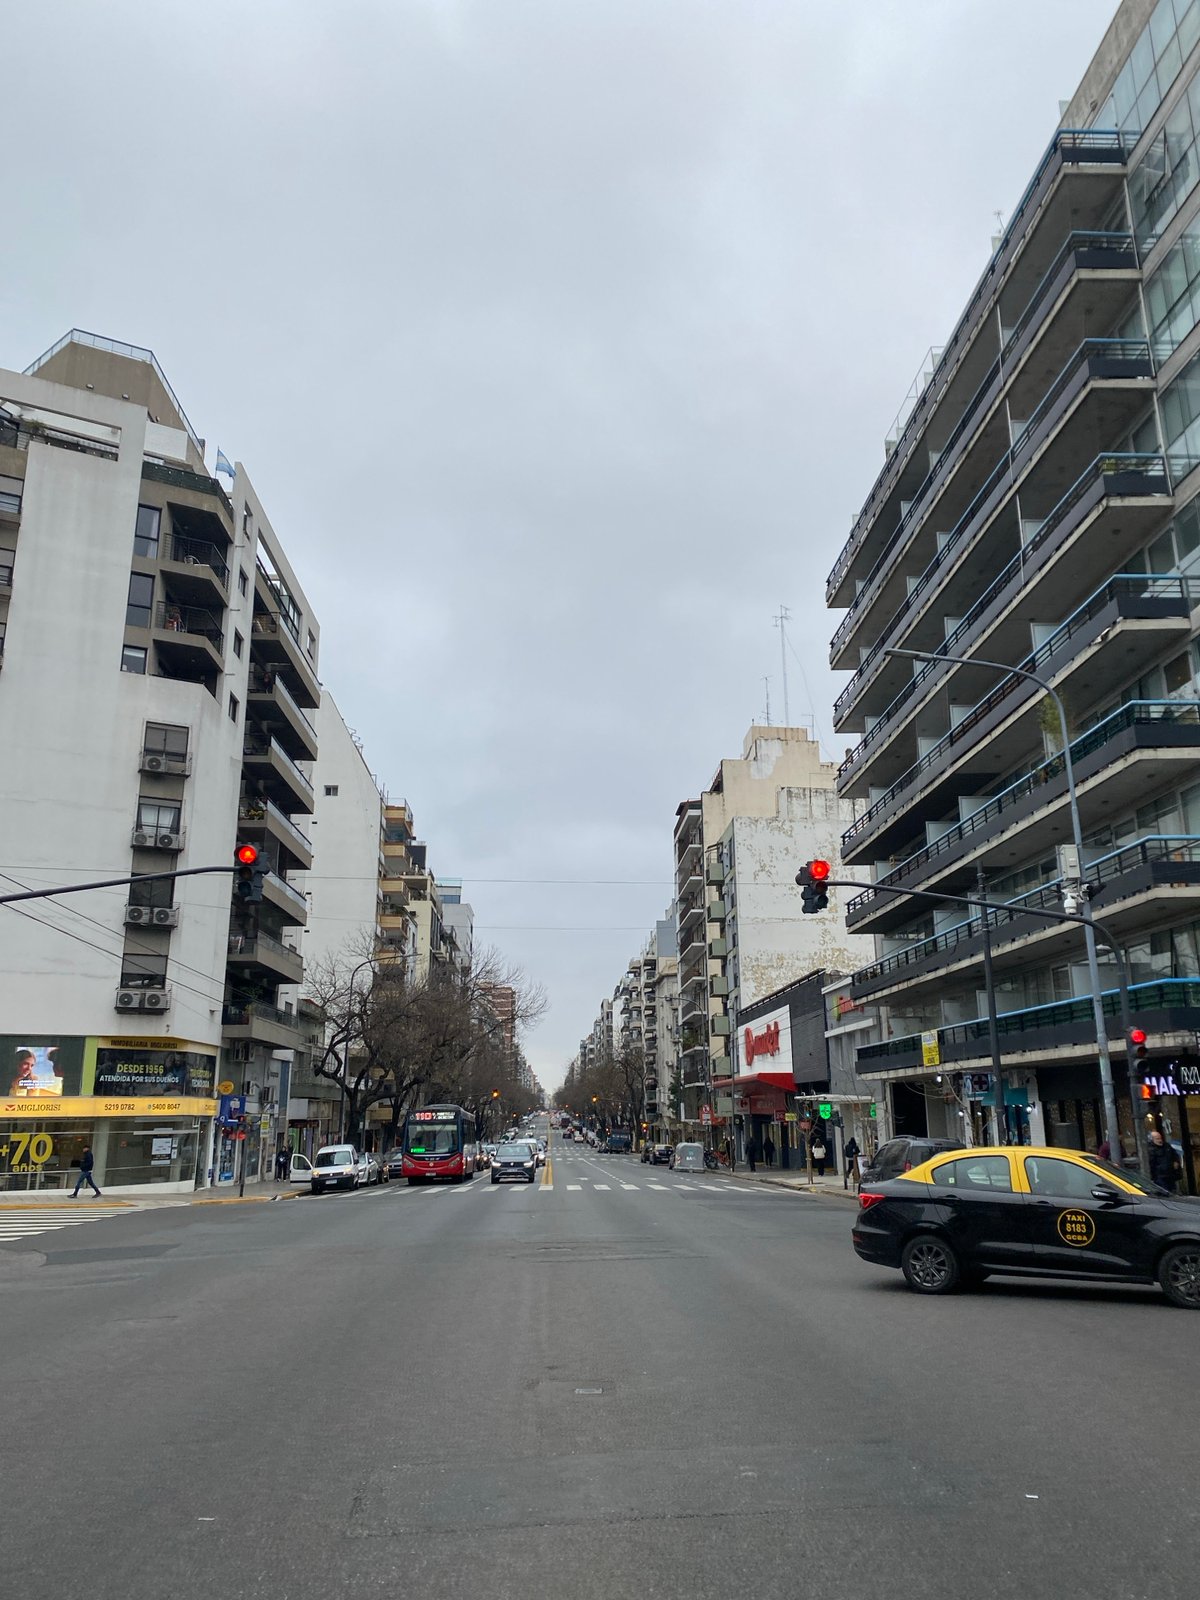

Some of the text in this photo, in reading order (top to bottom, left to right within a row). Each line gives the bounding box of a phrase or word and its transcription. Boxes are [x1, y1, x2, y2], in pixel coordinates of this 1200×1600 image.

[116, 1063, 164, 1074] DESDE 1956
[156, 1076, 179, 1084] DUEÑOS
[16, 1104, 61, 1112] MIGLIORISI
[104, 1103, 135, 1111] 5219 0782
[152, 1103, 181, 1111] 5400 8047
[415, 1112, 432, 1120] 110
[12, 1163, 43, 1172] años
[1066, 1214, 1086, 1222] TAXI
[1066, 1223, 1086, 1233] 8183
